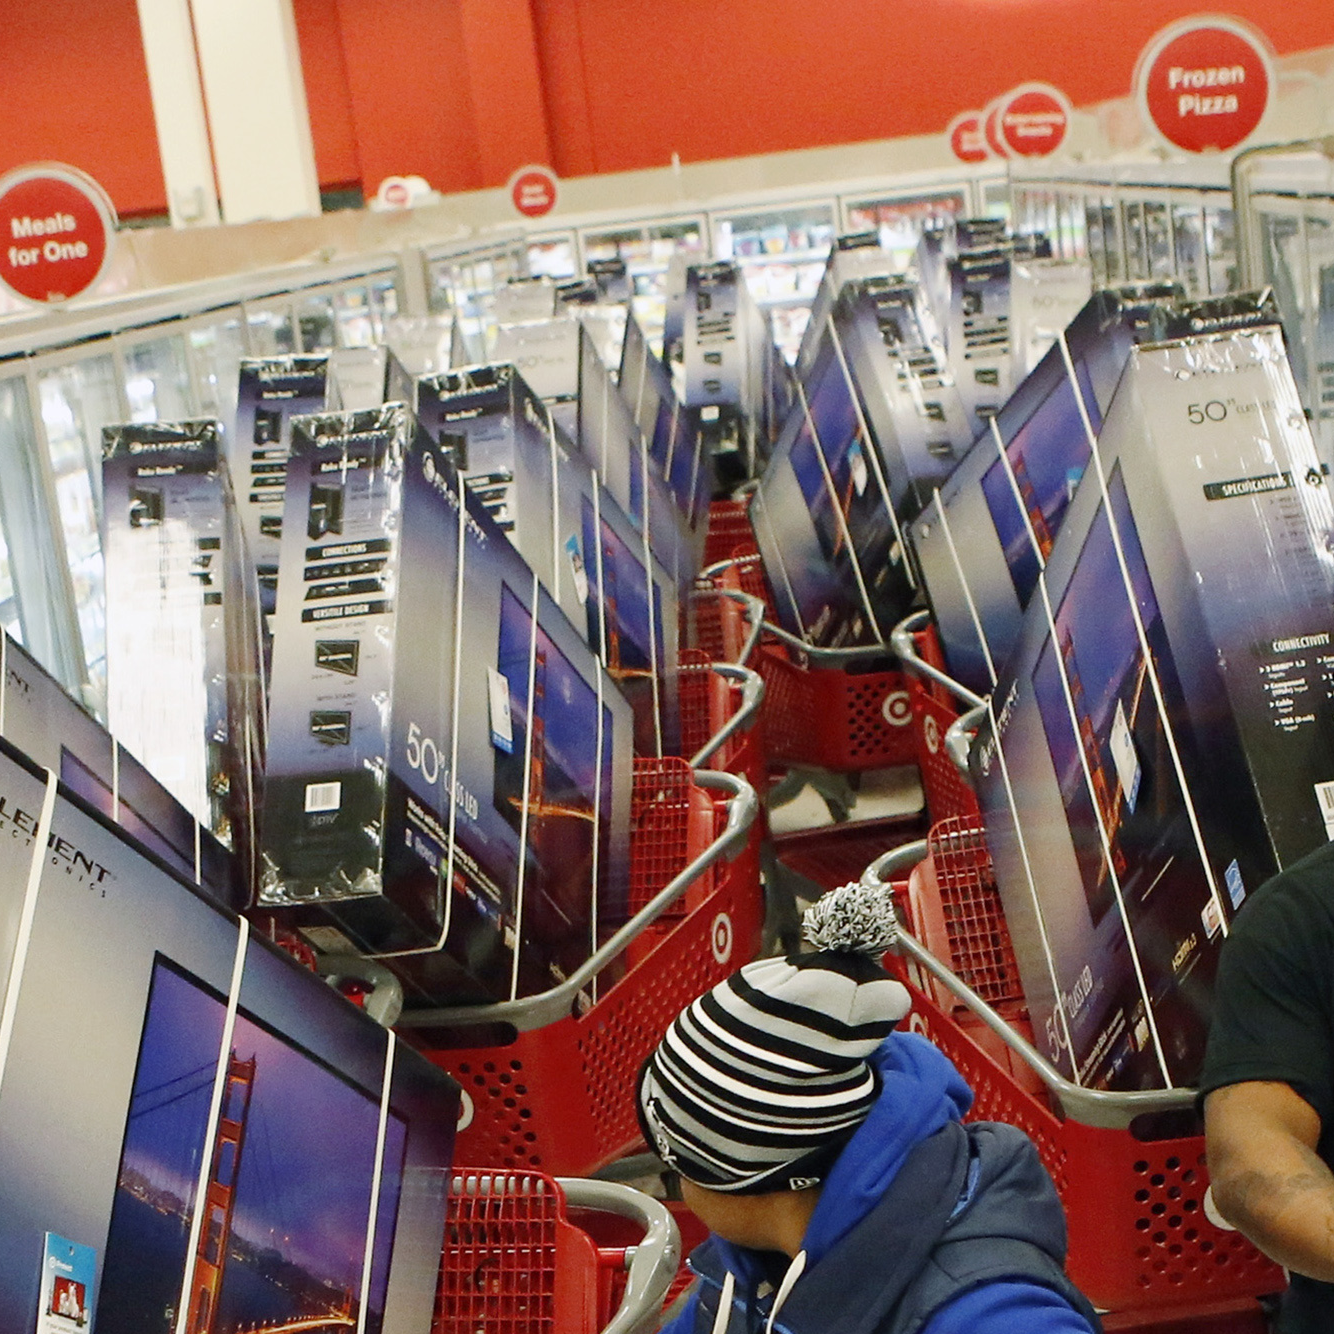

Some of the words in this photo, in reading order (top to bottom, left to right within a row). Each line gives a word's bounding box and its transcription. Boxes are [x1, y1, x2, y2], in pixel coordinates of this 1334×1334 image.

[1169, 66, 1245, 90] Frozen
[1179, 92, 1239, 117] Pizza
[10, 212, 77, 239] Meals
[9, 245, 40, 267] for
[44, 239, 88, 263] One
[1222, 472, 1288, 496] SPECIFICATIONS
[1273, 633, 1329, 652] CONNECTIVITY
